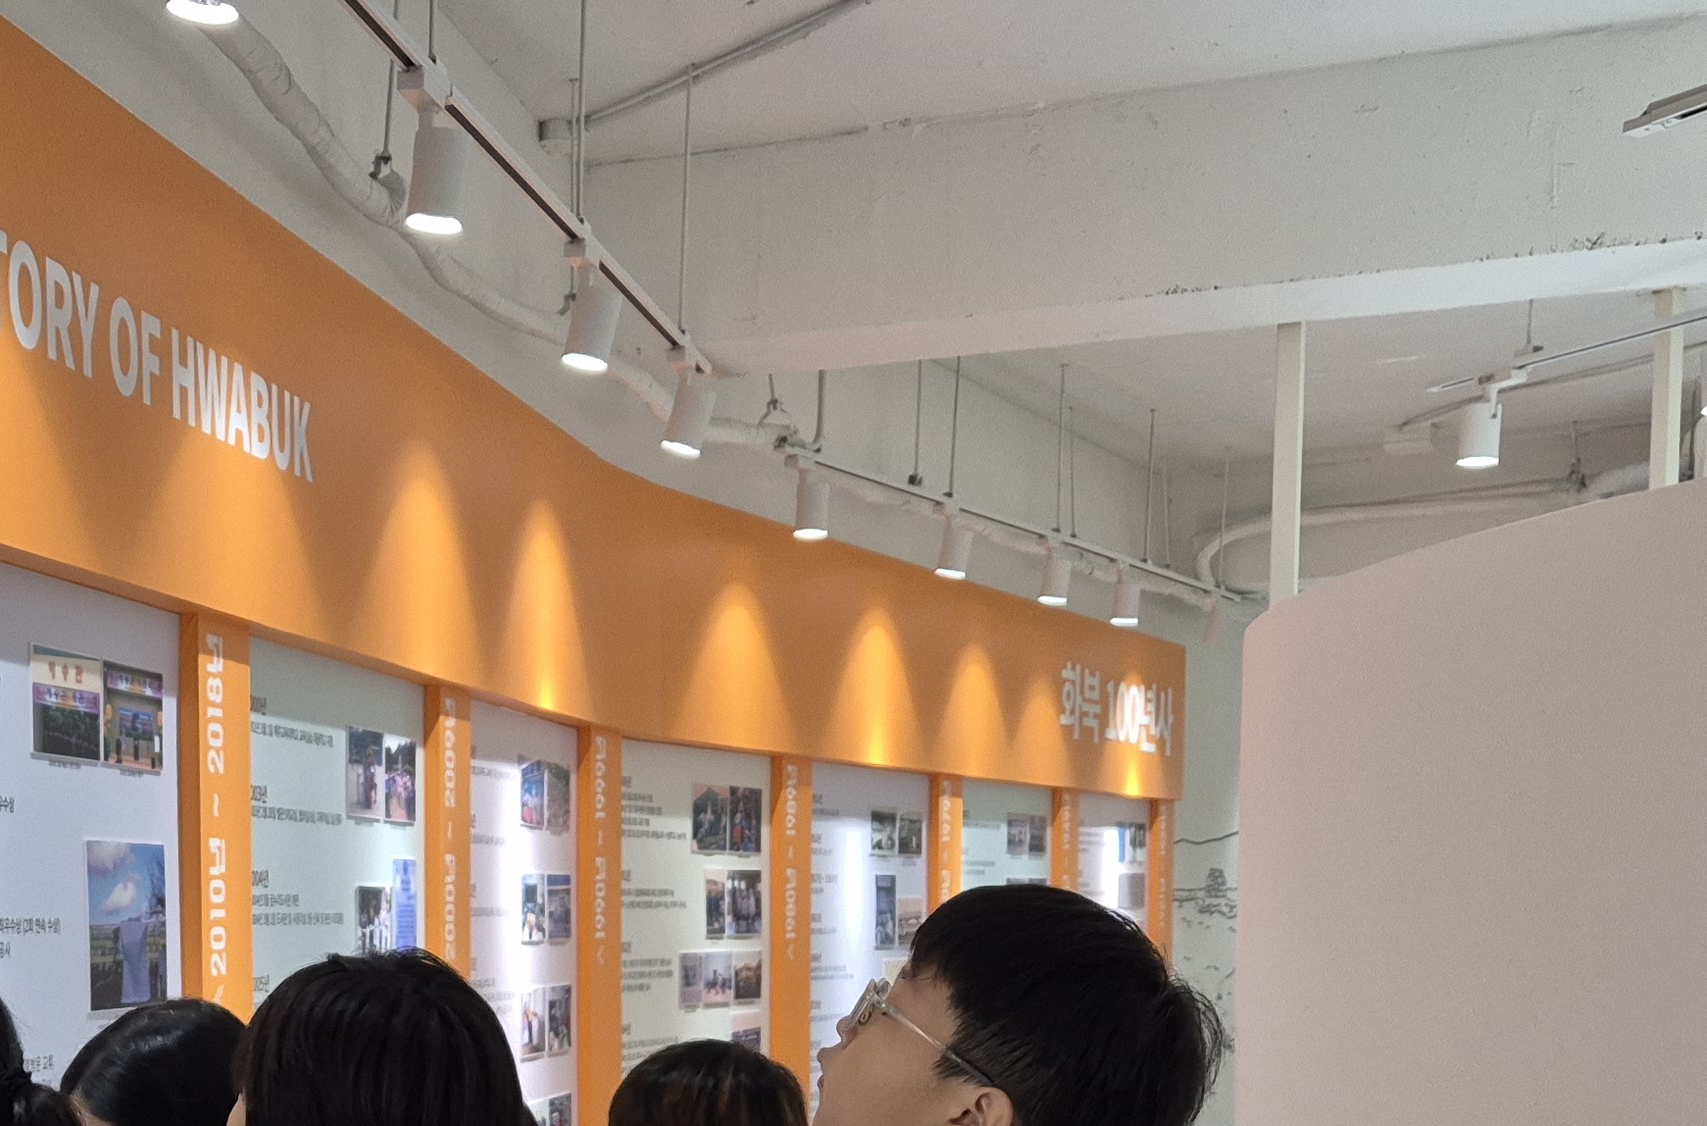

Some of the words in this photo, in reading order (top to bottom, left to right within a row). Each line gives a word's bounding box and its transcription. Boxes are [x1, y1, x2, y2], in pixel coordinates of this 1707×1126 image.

[109, 296, 161, 406] OF
[171, 327, 313, 483] HWABUK
[206, 633, 224, 775] 2018년
[1060, 660, 1101, 744] 화북
[209, 837, 227, 977] 2010년
